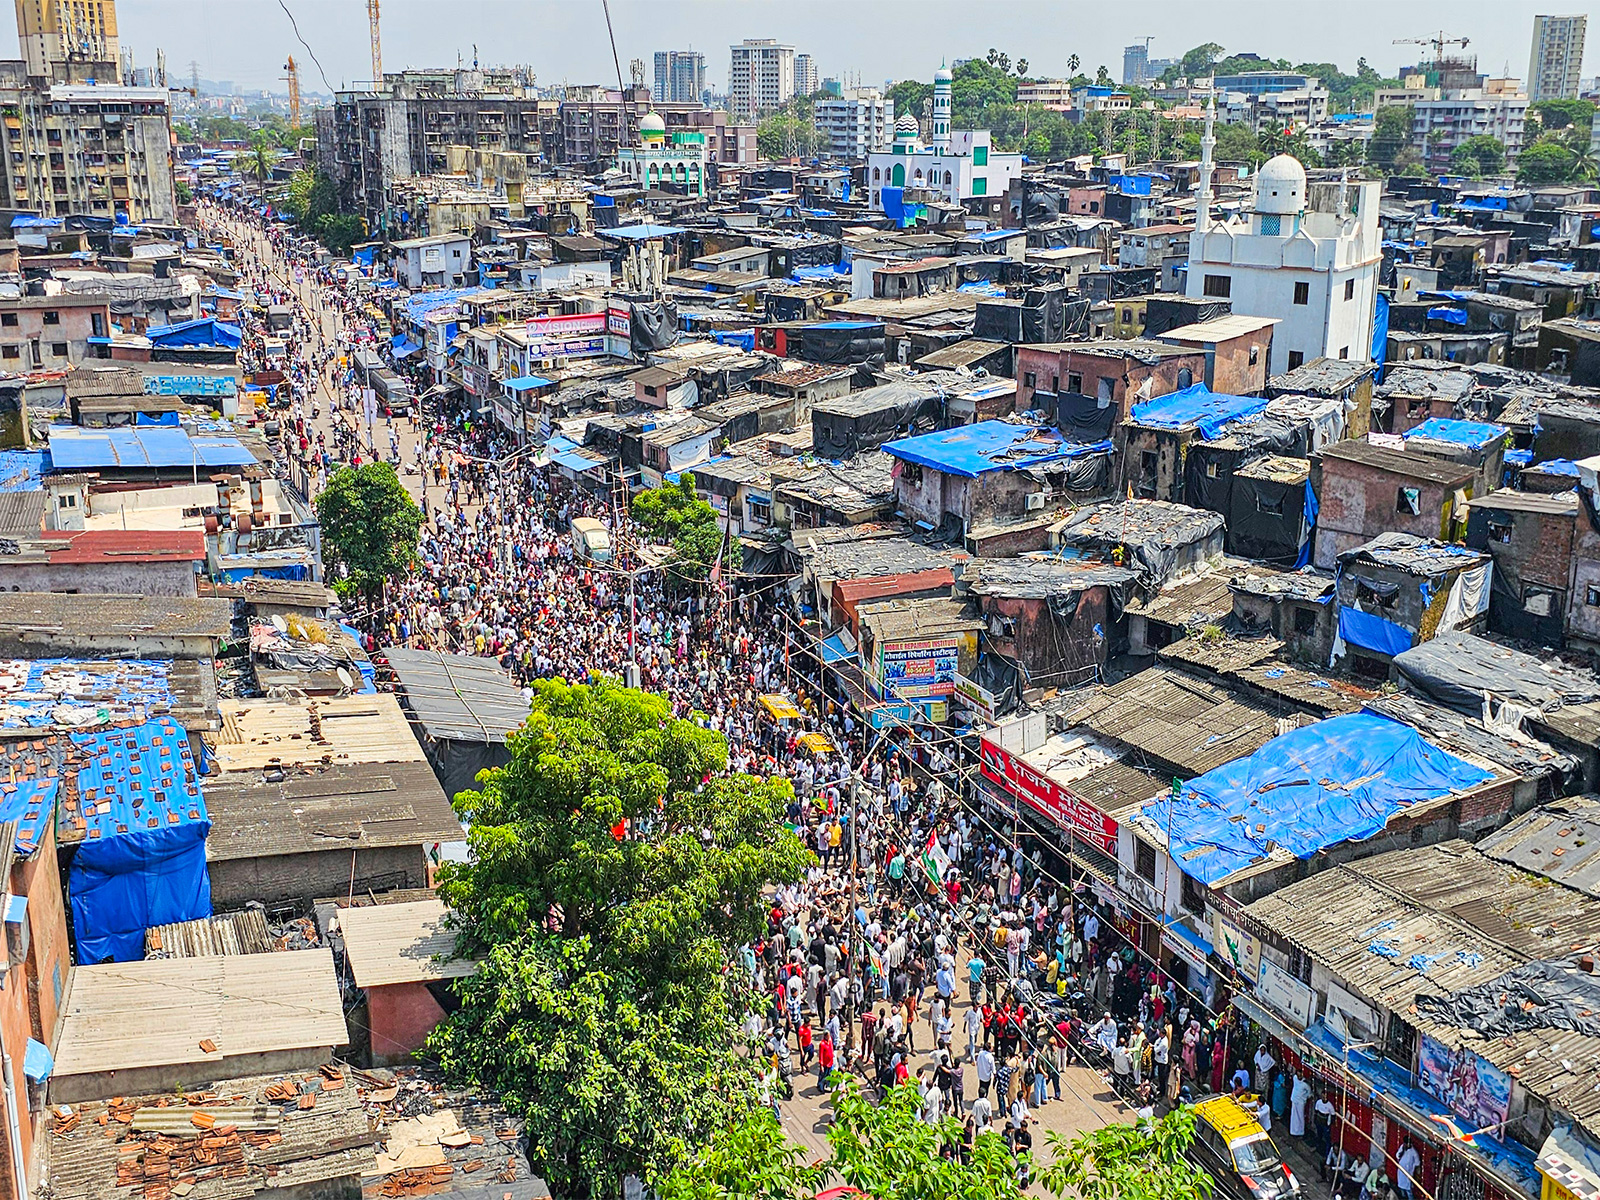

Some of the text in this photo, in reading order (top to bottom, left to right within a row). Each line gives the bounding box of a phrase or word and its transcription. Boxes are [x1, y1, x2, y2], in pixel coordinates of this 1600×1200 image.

[538, 319, 580, 332] VISION
[904, 641, 931, 649] REPAIRING
[932, 639, 956, 647] INSTITUTE
